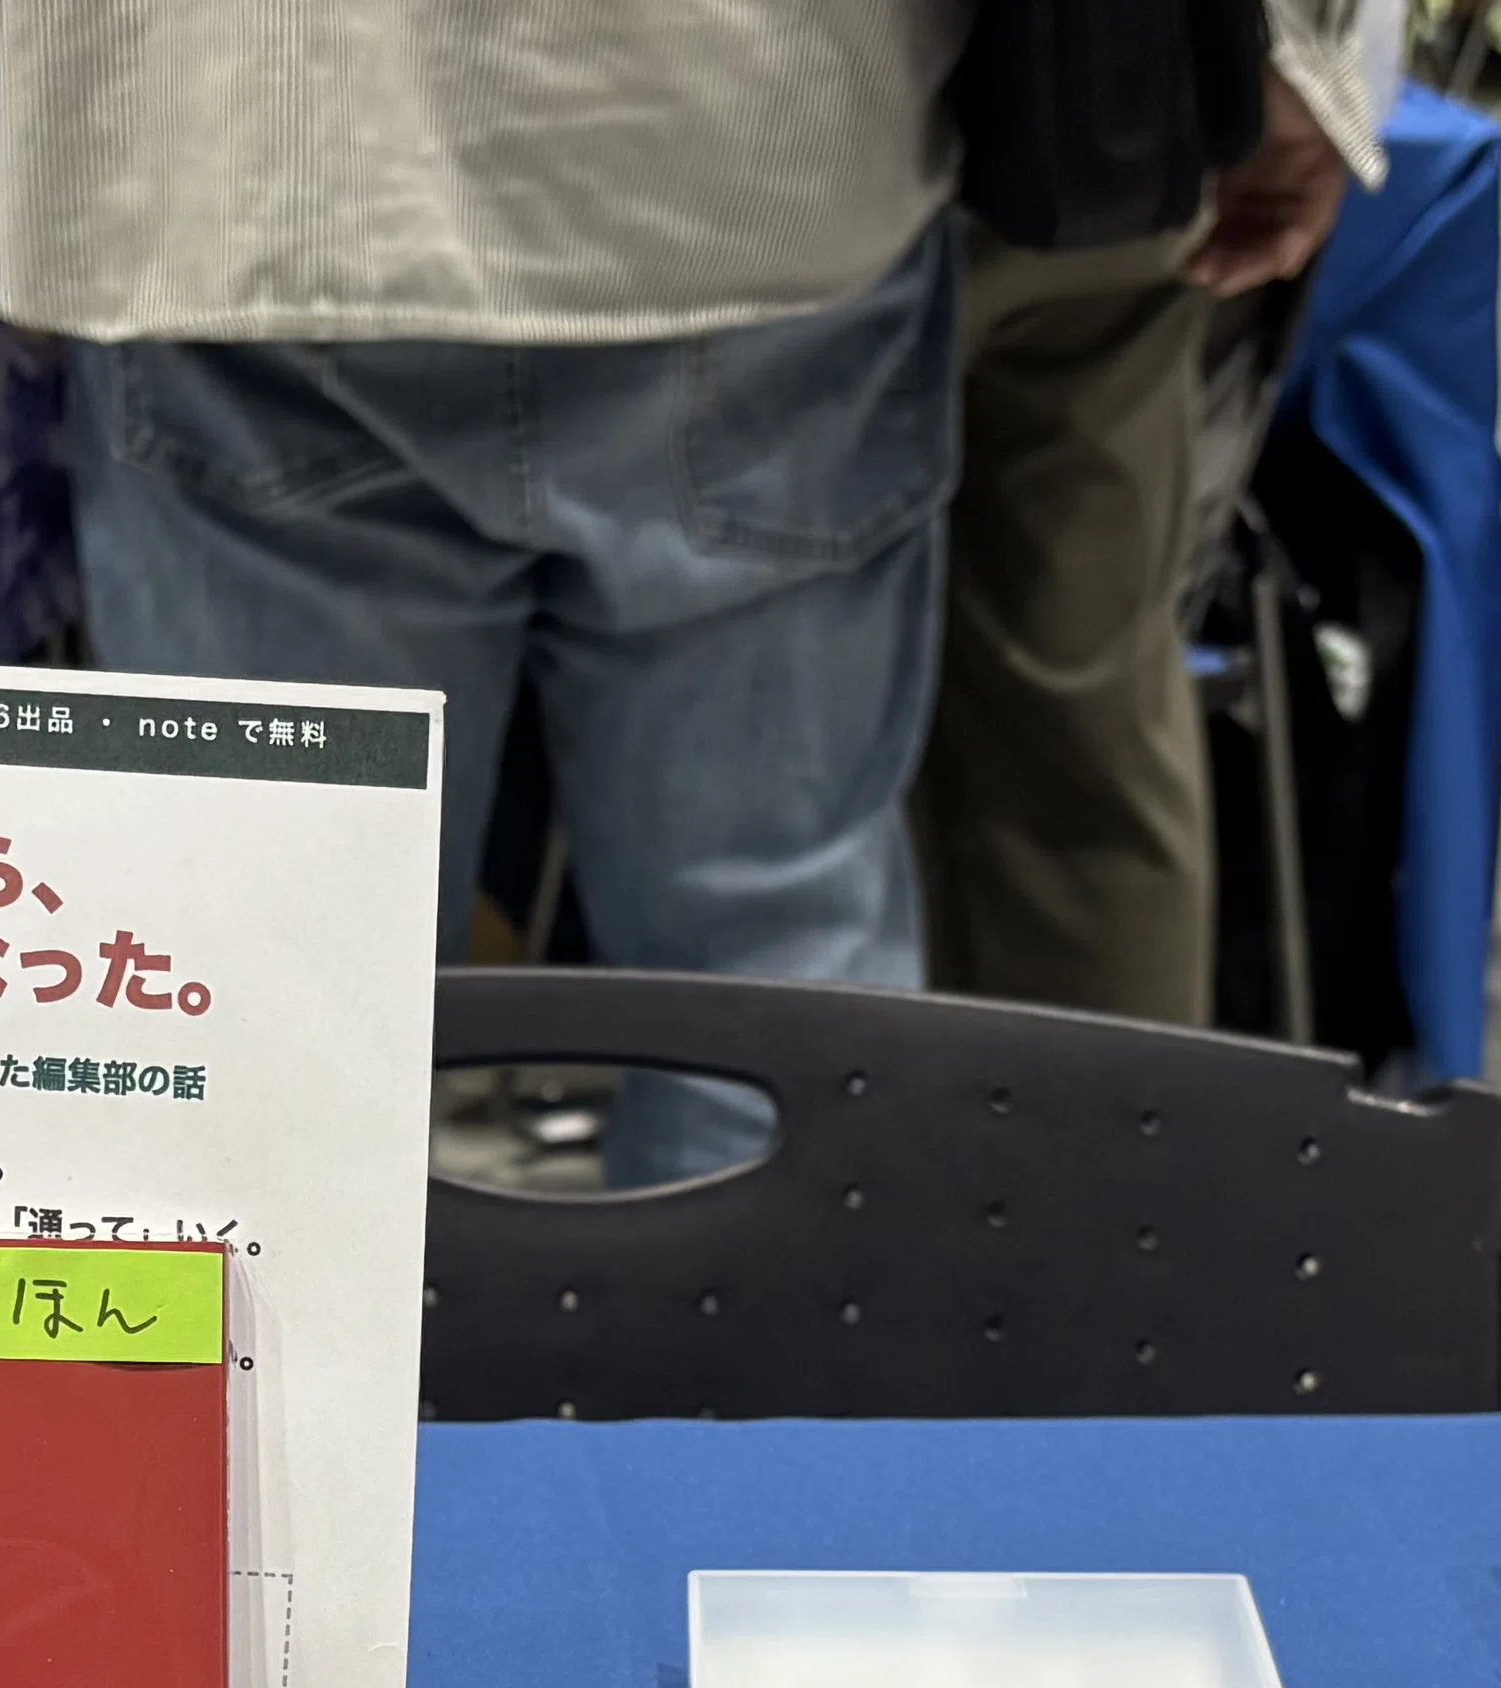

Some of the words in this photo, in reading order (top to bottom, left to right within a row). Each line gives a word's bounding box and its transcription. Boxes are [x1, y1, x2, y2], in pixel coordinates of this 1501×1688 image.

[139, 717, 217, 740] note
[238, 718, 326, 748] で無料
